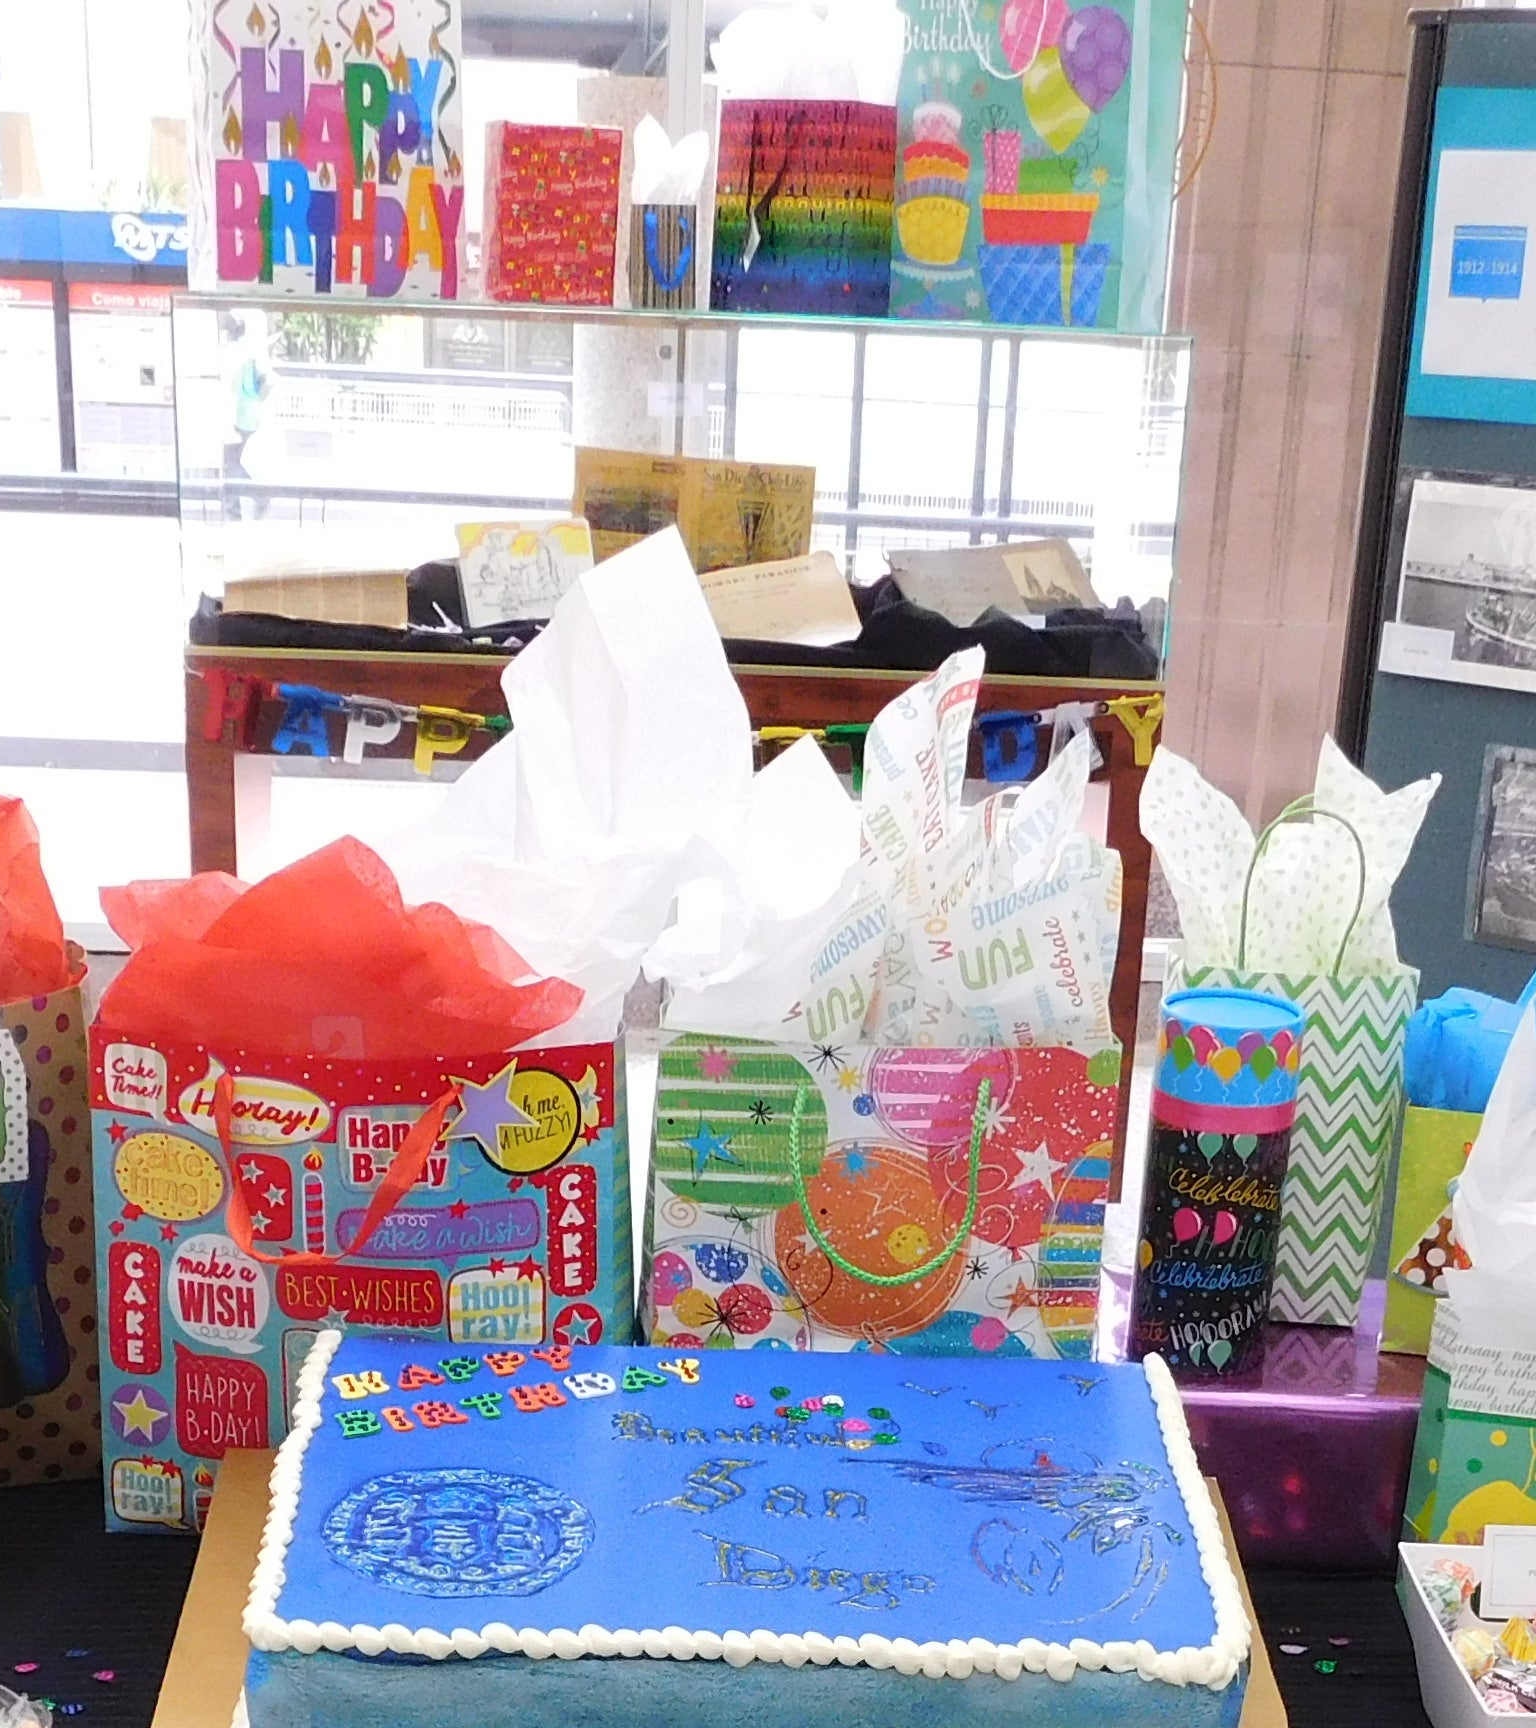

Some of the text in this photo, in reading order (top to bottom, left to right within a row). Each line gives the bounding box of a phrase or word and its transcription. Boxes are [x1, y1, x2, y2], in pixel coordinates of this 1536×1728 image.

[240, 46, 443, 188] HAPPY
[215, 158, 464, 300] BIRTHDAY
[1042, 916, 1084, 1008] celebrate
[189, 1087, 321, 1137] Horay!
[177, 1247, 235, 1280] make
[558, 1172, 587, 1288] CAKE
[123, 1252, 148, 1364] CAKE
[177, 1278, 257, 1329] WISH
[347, 1277, 435, 1314] WISHES
[186, 1372, 257, 1412] HAPPY
[331, 1344, 573, 1400] HAPPY
[334, 1357, 703, 1440] BIRTHDAY
